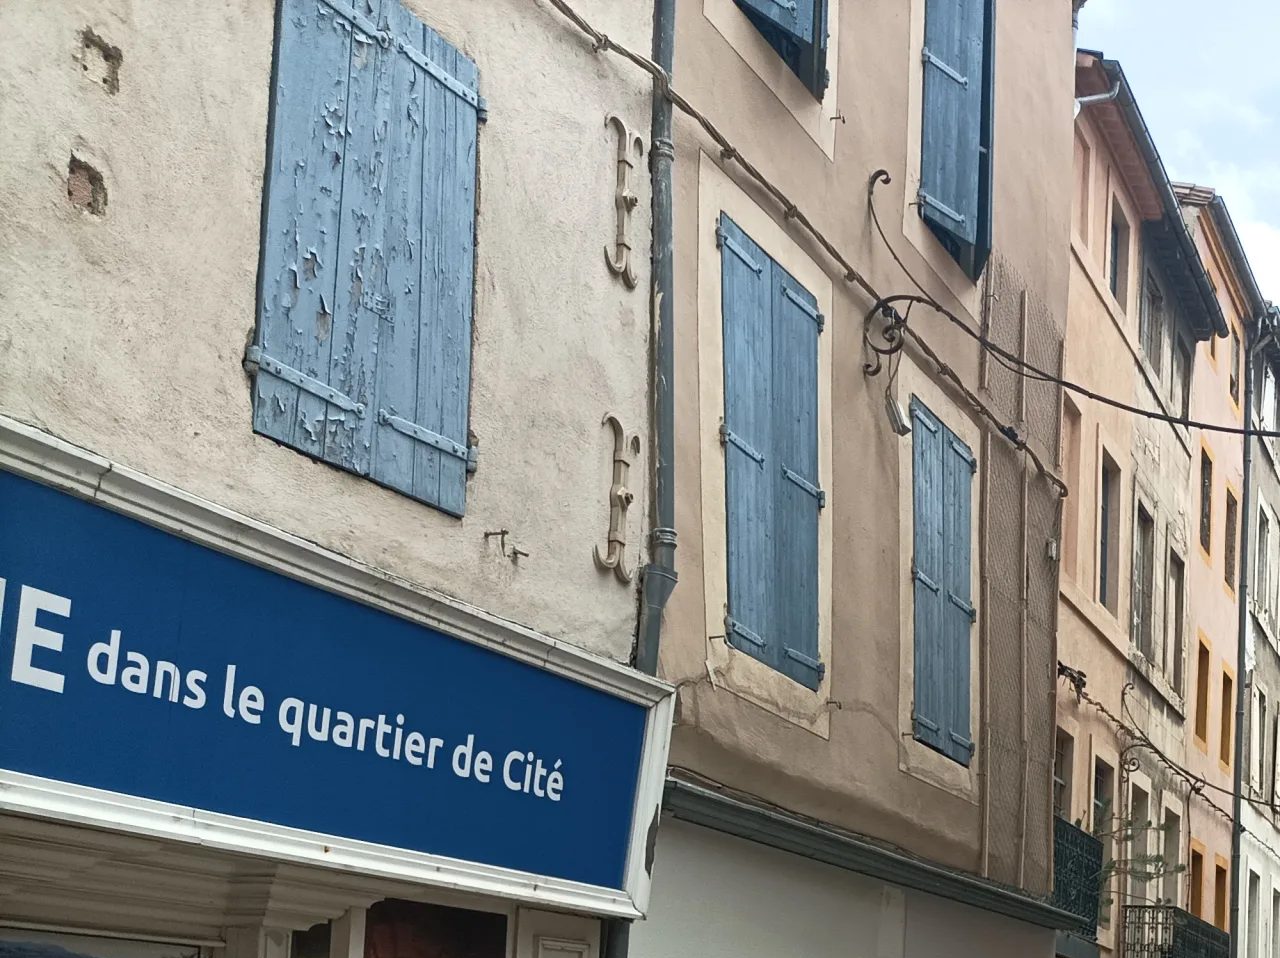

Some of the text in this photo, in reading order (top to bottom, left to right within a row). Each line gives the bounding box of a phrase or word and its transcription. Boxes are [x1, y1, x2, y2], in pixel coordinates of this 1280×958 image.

[0, 577, 564, 801] E dans le quartier de Cité
